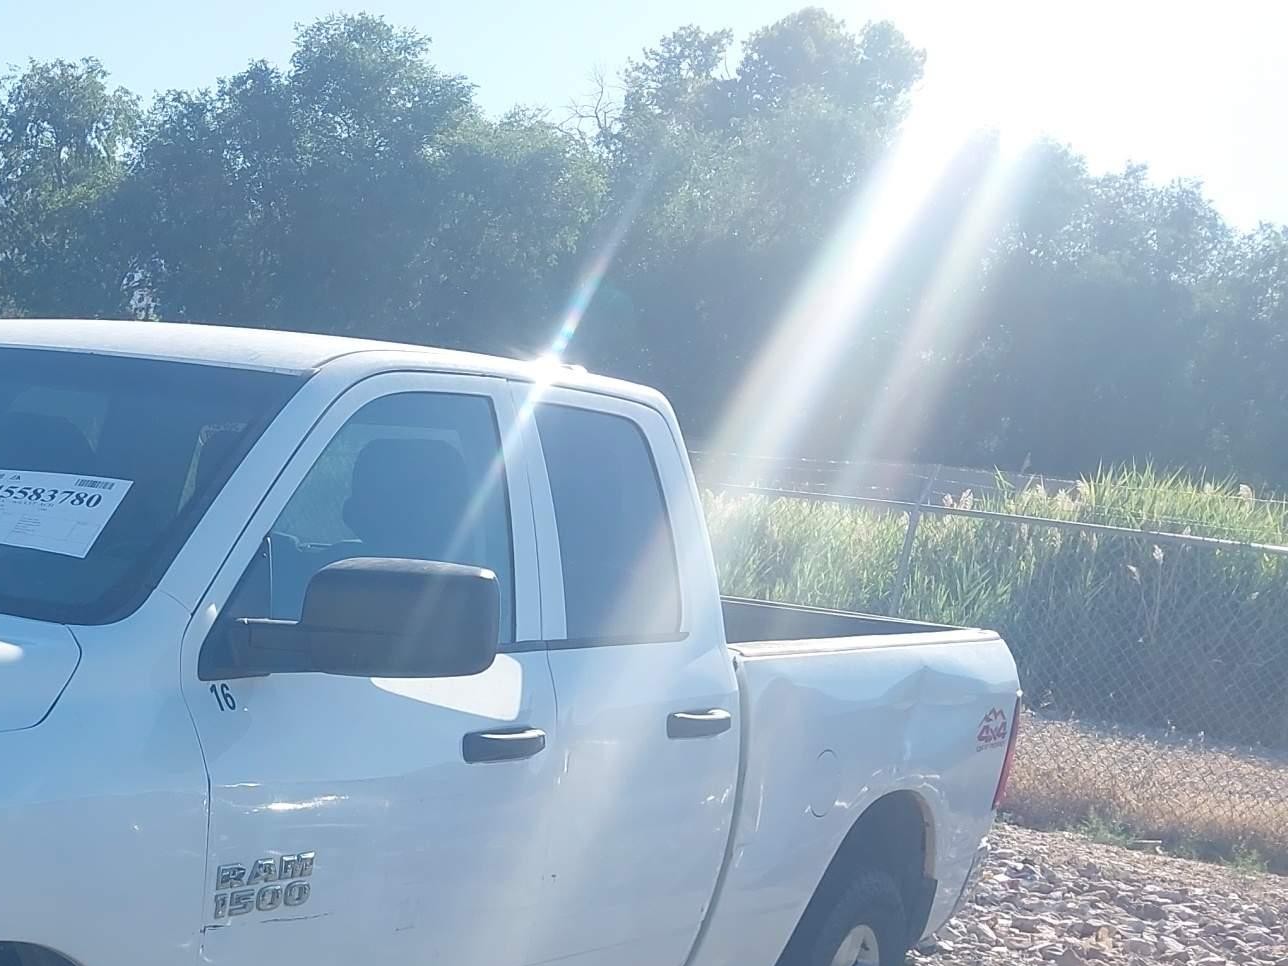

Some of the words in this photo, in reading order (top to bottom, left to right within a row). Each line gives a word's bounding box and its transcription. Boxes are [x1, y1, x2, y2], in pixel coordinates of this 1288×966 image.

[209, 682, 237, 712] 16
[215, 851, 316, 890] RAM
[214, 880, 311, 919] 1500
